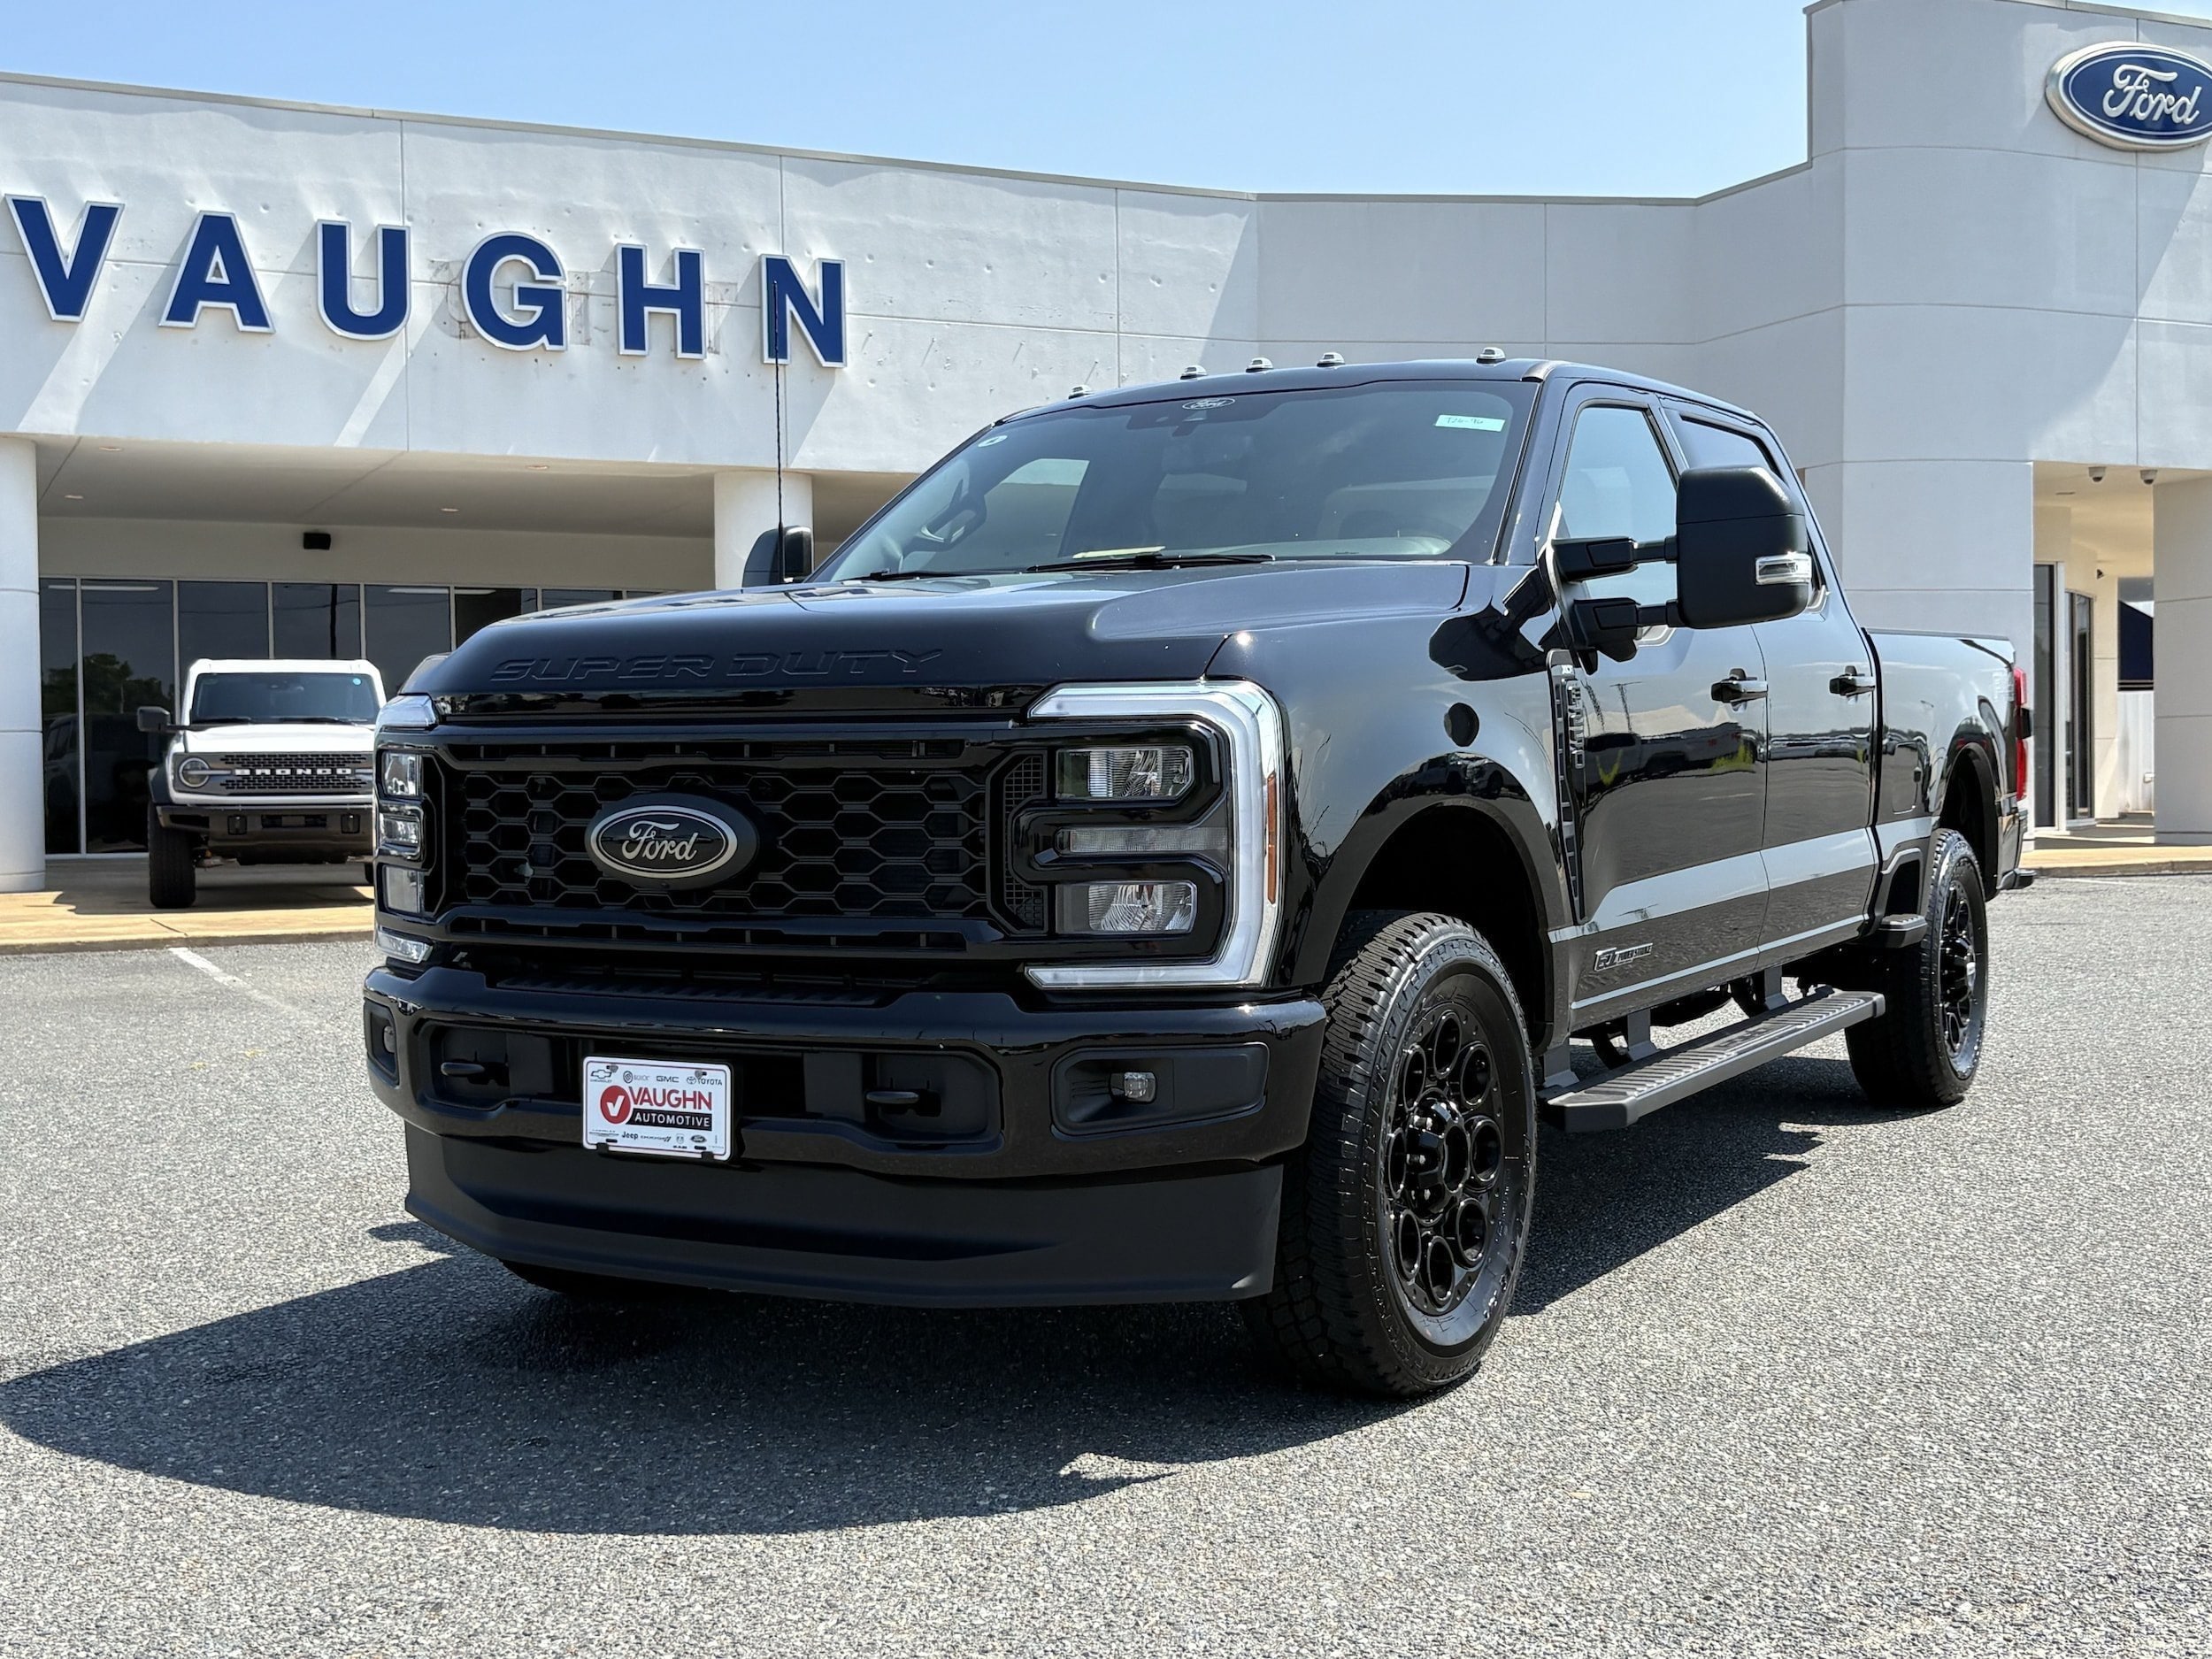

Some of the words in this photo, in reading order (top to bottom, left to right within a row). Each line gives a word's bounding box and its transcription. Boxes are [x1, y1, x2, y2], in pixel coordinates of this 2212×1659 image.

[2102, 64, 2202, 125] Ford
[4, 192, 848, 368] VAUGHN
[489, 654, 716, 681] SUPER
[726, 649, 944, 677] DUTY
[622, 820, 699, 861] Ford
[656, 1075, 680, 1084] GMC
[697, 1077, 723, 1087] TOYOTA
[628, 1086, 712, 1111] VAUGHN
[634, 1112, 710, 1127] AUTOMOTIVE
[621, 1131, 639, 1141] Jeep
